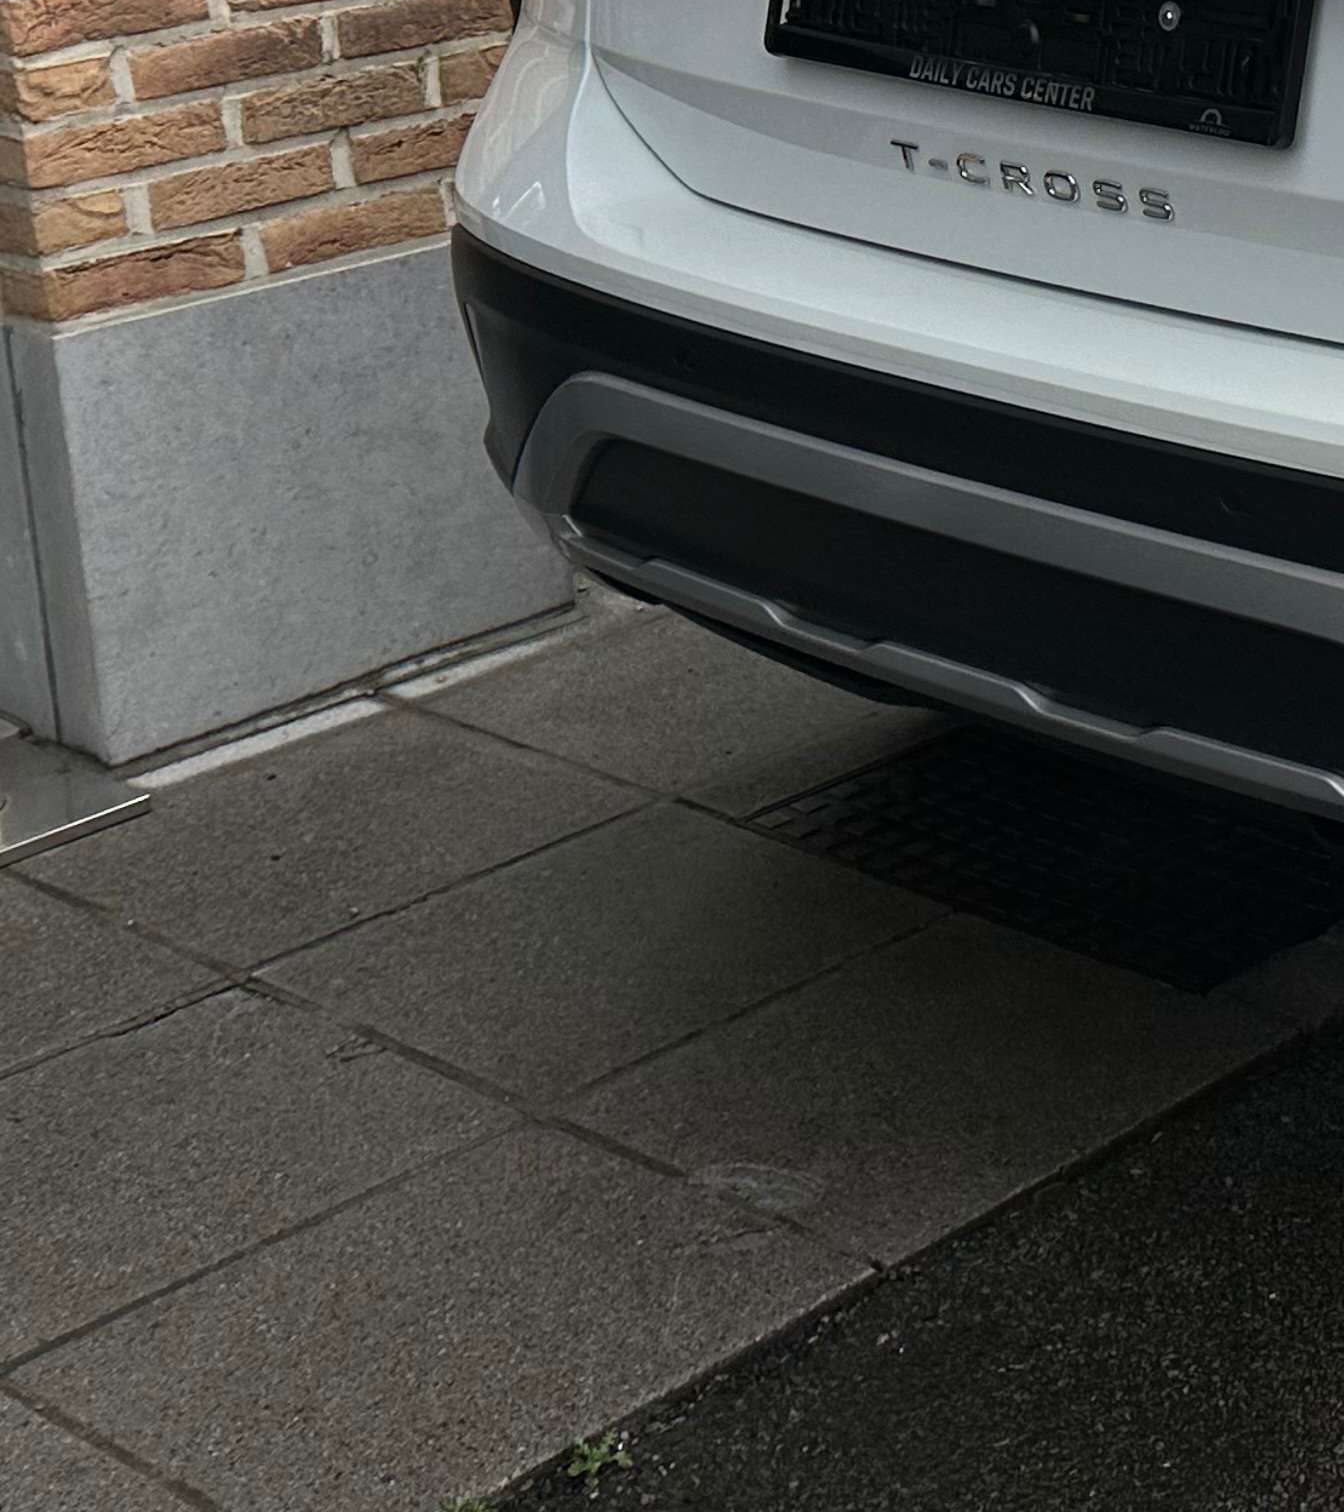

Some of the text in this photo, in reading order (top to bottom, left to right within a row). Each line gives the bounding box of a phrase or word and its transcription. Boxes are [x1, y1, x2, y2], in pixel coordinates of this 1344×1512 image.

[909, 55, 1096, 111] DAILY CARS CENTER
[890, 139, 1176, 223] T-CROSS
